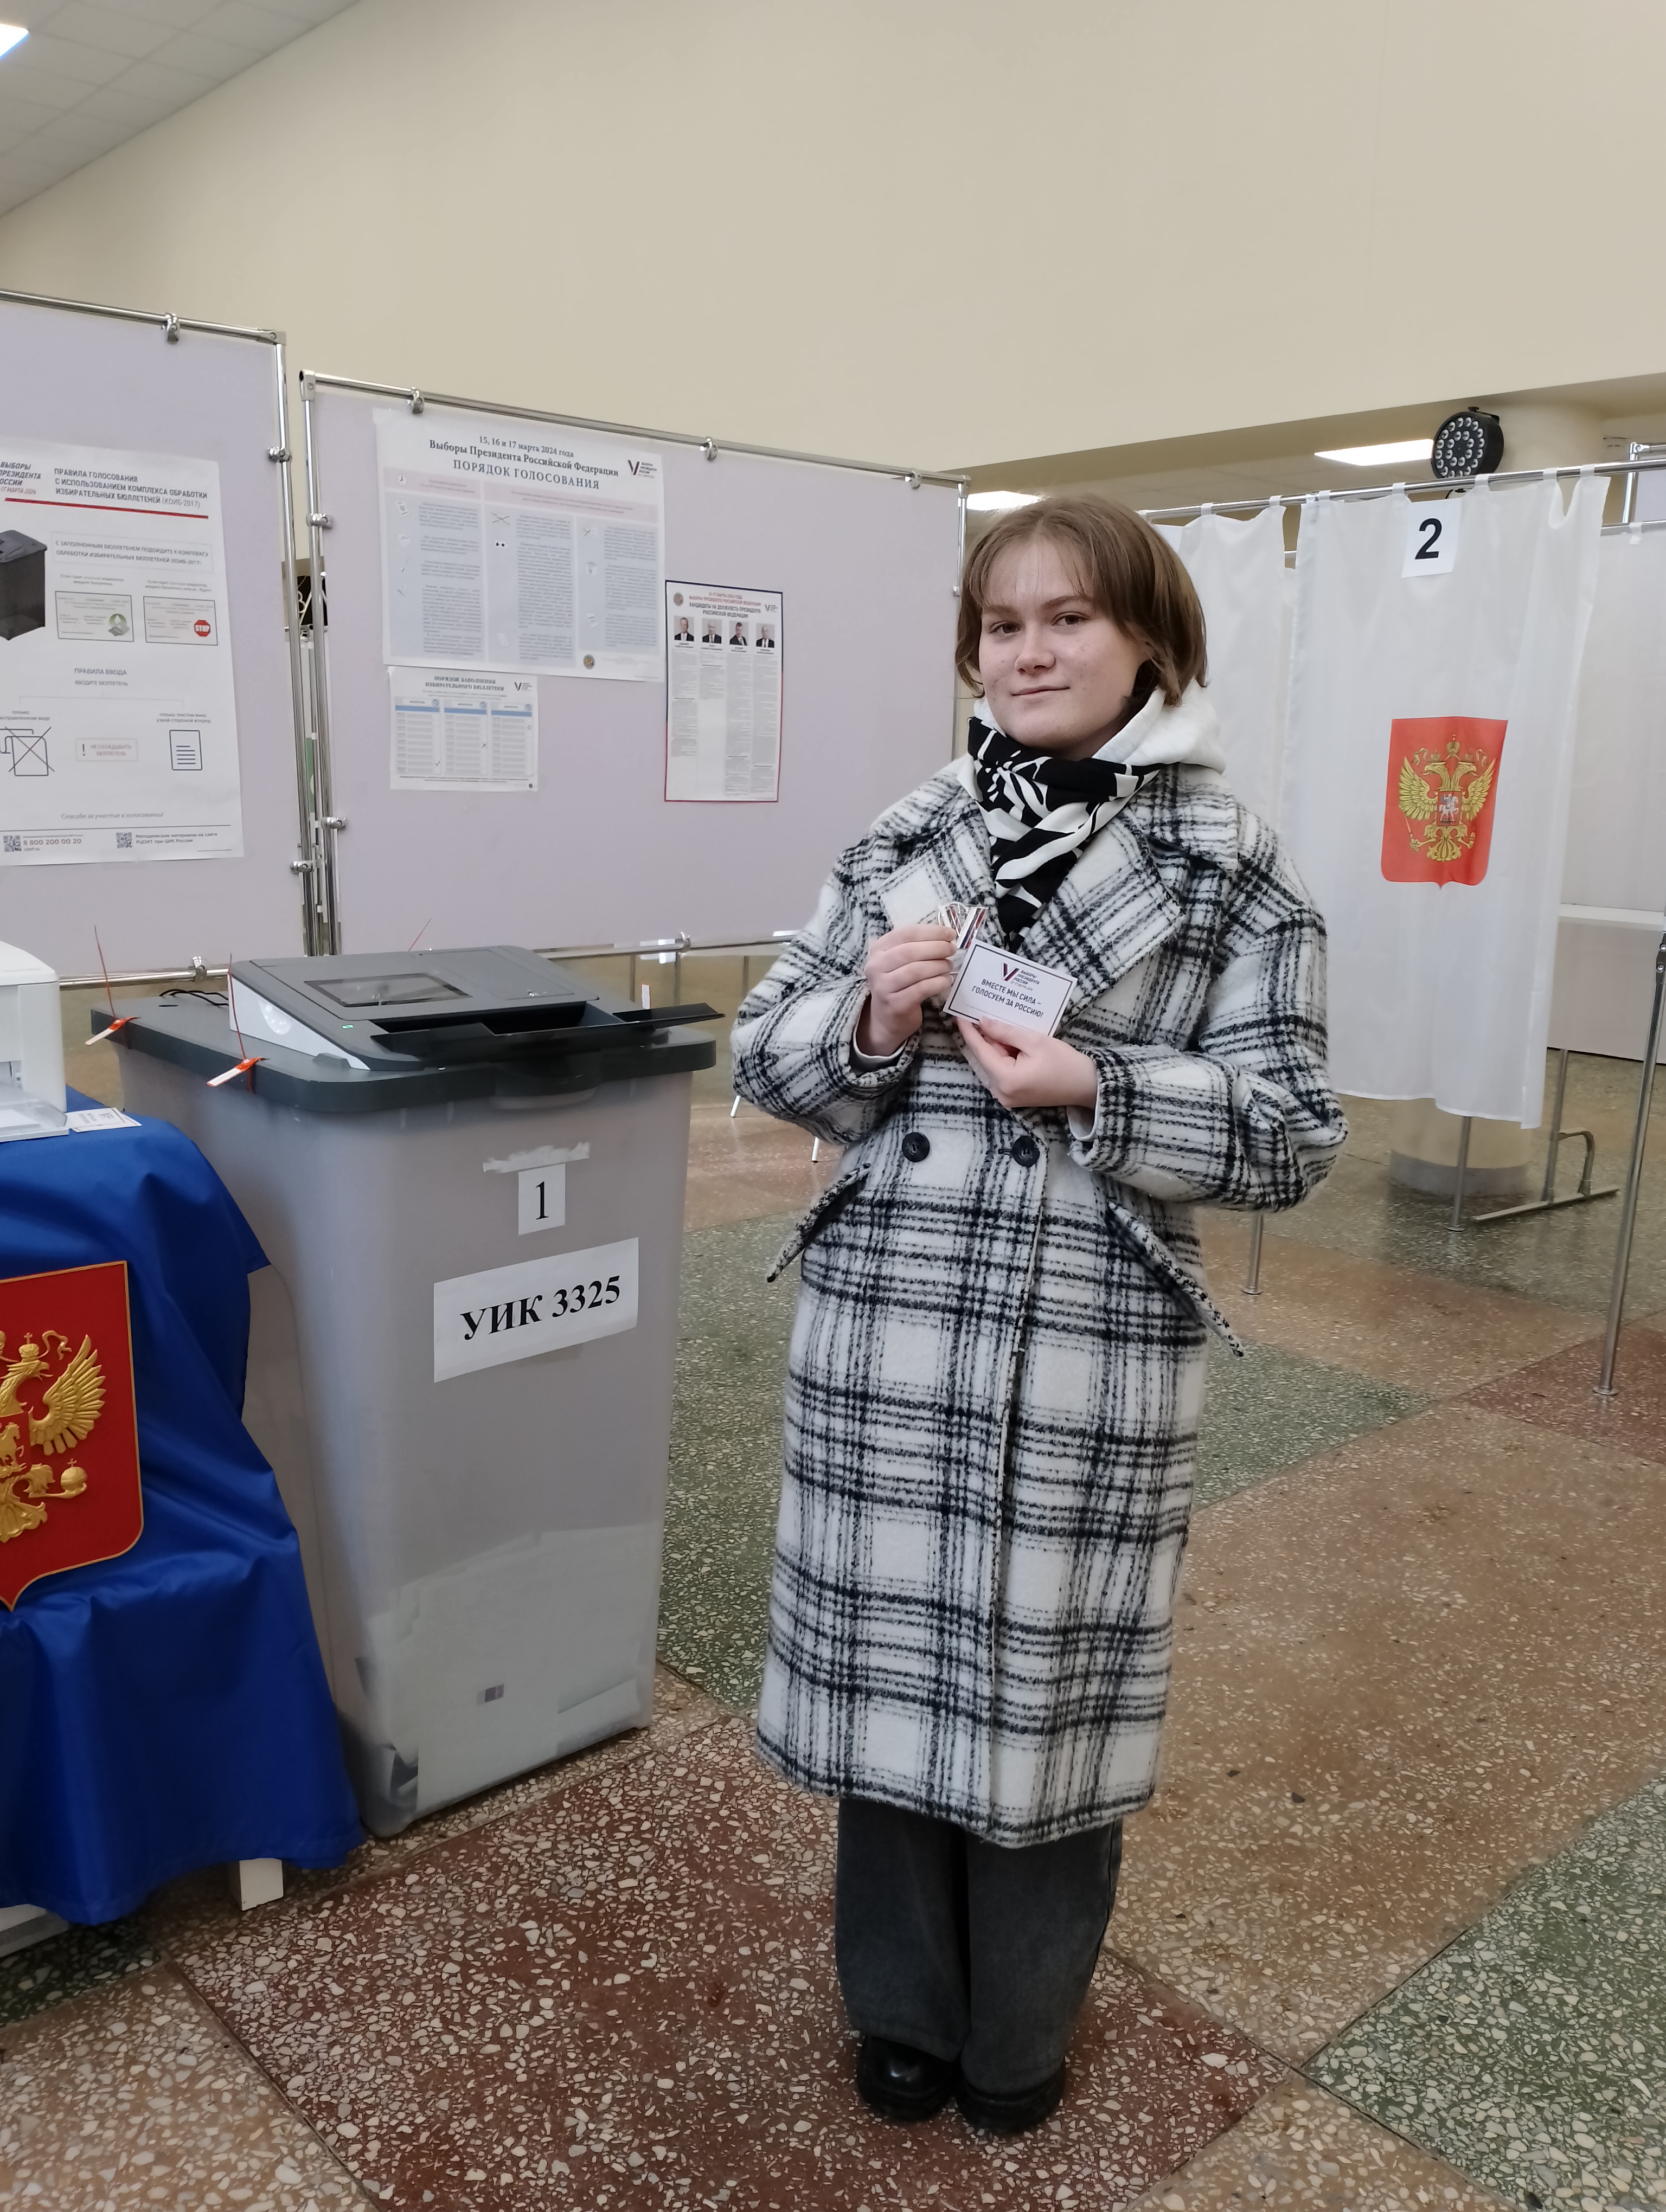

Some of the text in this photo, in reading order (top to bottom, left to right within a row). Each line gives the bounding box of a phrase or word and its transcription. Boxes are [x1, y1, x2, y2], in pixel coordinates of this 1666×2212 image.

[430, 440, 619, 477] Выборы Президента Российской Федерации
[480, 436, 490, 445] 15,
[492, 438, 500, 446] 16
[509, 440, 516, 448] 17
[518, 443, 539, 452] марта
[541, 446, 557, 455] 2024
[1, 461, 31, 470] ВЫБОРЫ
[54, 468, 138, 483] ПРАВИЛА ГОЛОСОВАНИЯ
[453, 459, 599, 489] ПОРЯДОК ГОЛОСОВАНИЯ
[56, 488, 200, 509] ИЗБИРАТЕЛЬНЫХ БЮЛЛЕТЕНЕЙ (КОИБ-2017)
[61, 479, 126, 491] ИСПОЛЬЗОВАНИЕМ
[128, 486, 168, 495] КОМПЛЕКСА
[169, 490, 208, 498] ОБРАБОТКИ
[1414, 518, 1442, 560] 2
[972, 986, 1005, 1003] ГОЛОСУЕМ
[1005, 999, 1013, 1007] ЗА
[1014, 1002, 1043, 1018] РОССИЮ!
[982, 979, 1007, 993] ВМЕСТЕ
[1007, 988, 1019, 998] МЫ
[1020, 993, 1036, 1005] СИЛА
[536, 1181, 548, 1220] 1
[460, 1275, 620, 1340] УИК 3325
